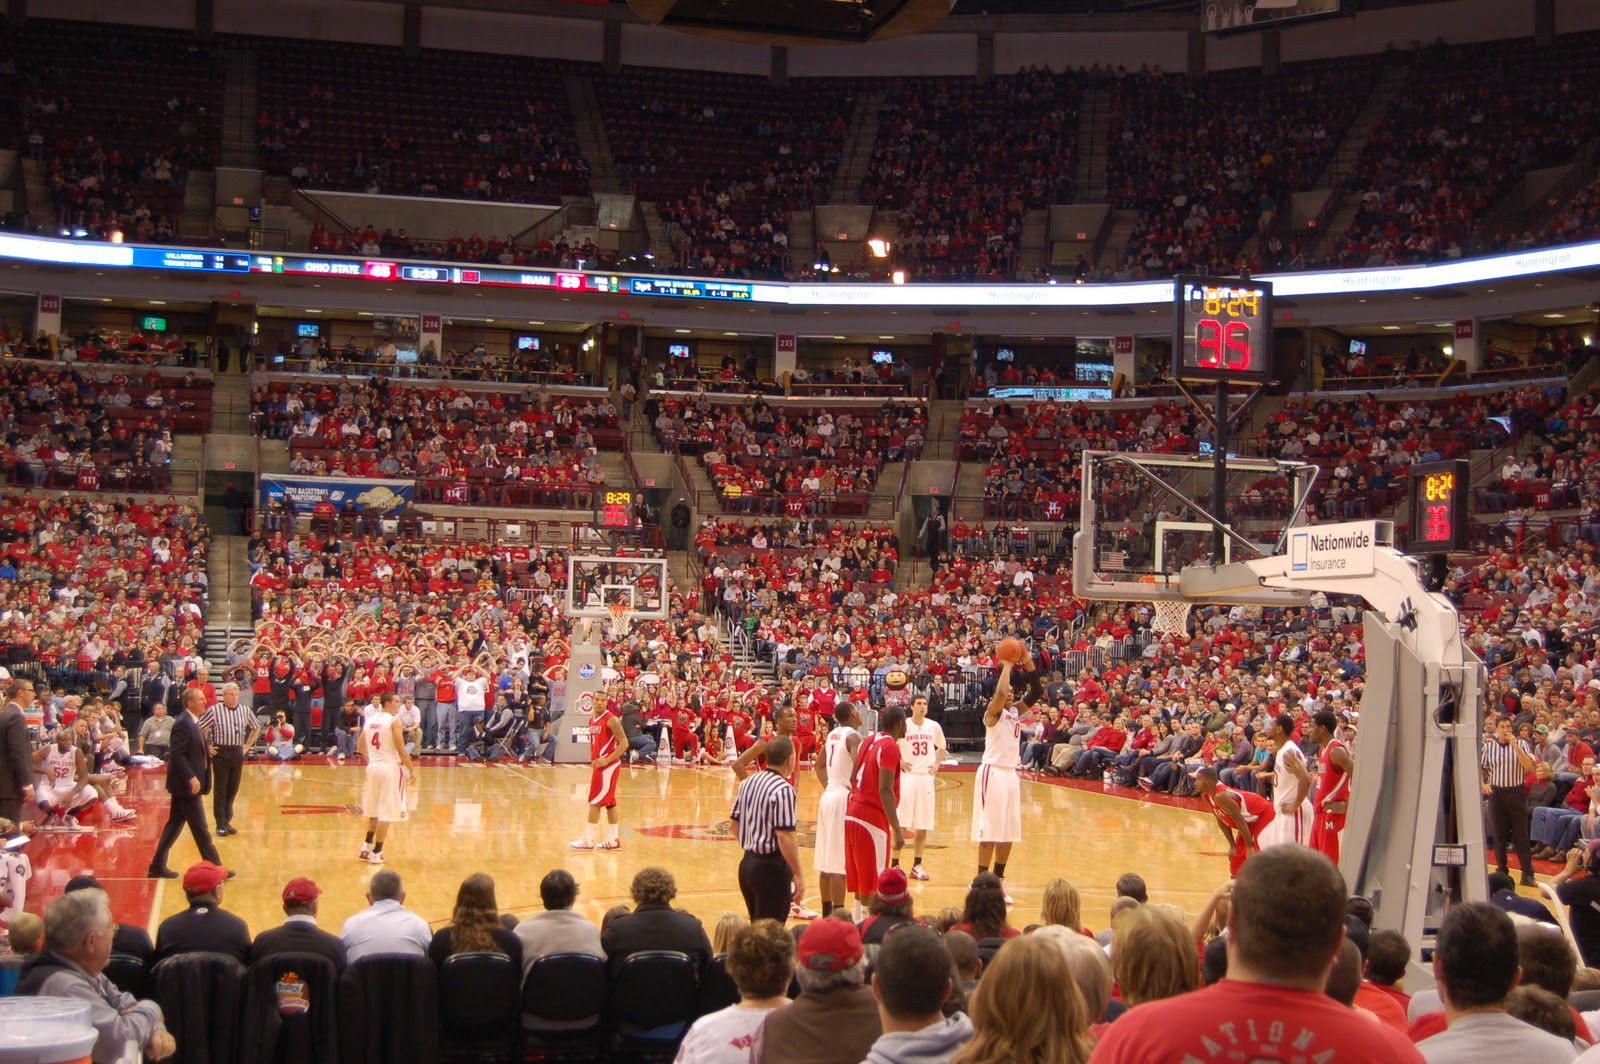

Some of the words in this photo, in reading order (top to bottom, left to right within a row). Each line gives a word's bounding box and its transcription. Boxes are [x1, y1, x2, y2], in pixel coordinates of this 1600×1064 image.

[1515, 253, 1571, 268] Huntington
[305, 262, 331, 273] OHIO
[331, 264, 360, 275] STATE
[521, 274, 551, 286] MIAMI
[1343, 275, 1404, 287] Huntington
[43, 300, 58, 308] 213
[425, 320, 439, 328] 214
[779, 339, 793, 347] 215
[1117, 341, 1131, 349] 217
[1199, 319, 1251, 370] 35
[82, 476, 96, 484] 111
[606, 491, 631, 505] 8:29
[1537, 494, 1549, 503] 118
[790, 502, 803, 511] 117
[603, 504, 628, 527] 35
[1426, 506, 1450, 541] 35
[1311, 531, 1369, 552] Nationwide
[1310, 558, 1346, 570] Insurance
[572, 726, 590, 735] MUSC
[371, 731, 381, 750] 4
[912, 741, 929, 756] 33
[829, 744, 835, 767] 1
[53, 766, 70, 779] 52
[856, 762, 866, 789] 4
[1325, 821, 1334, 830] M
